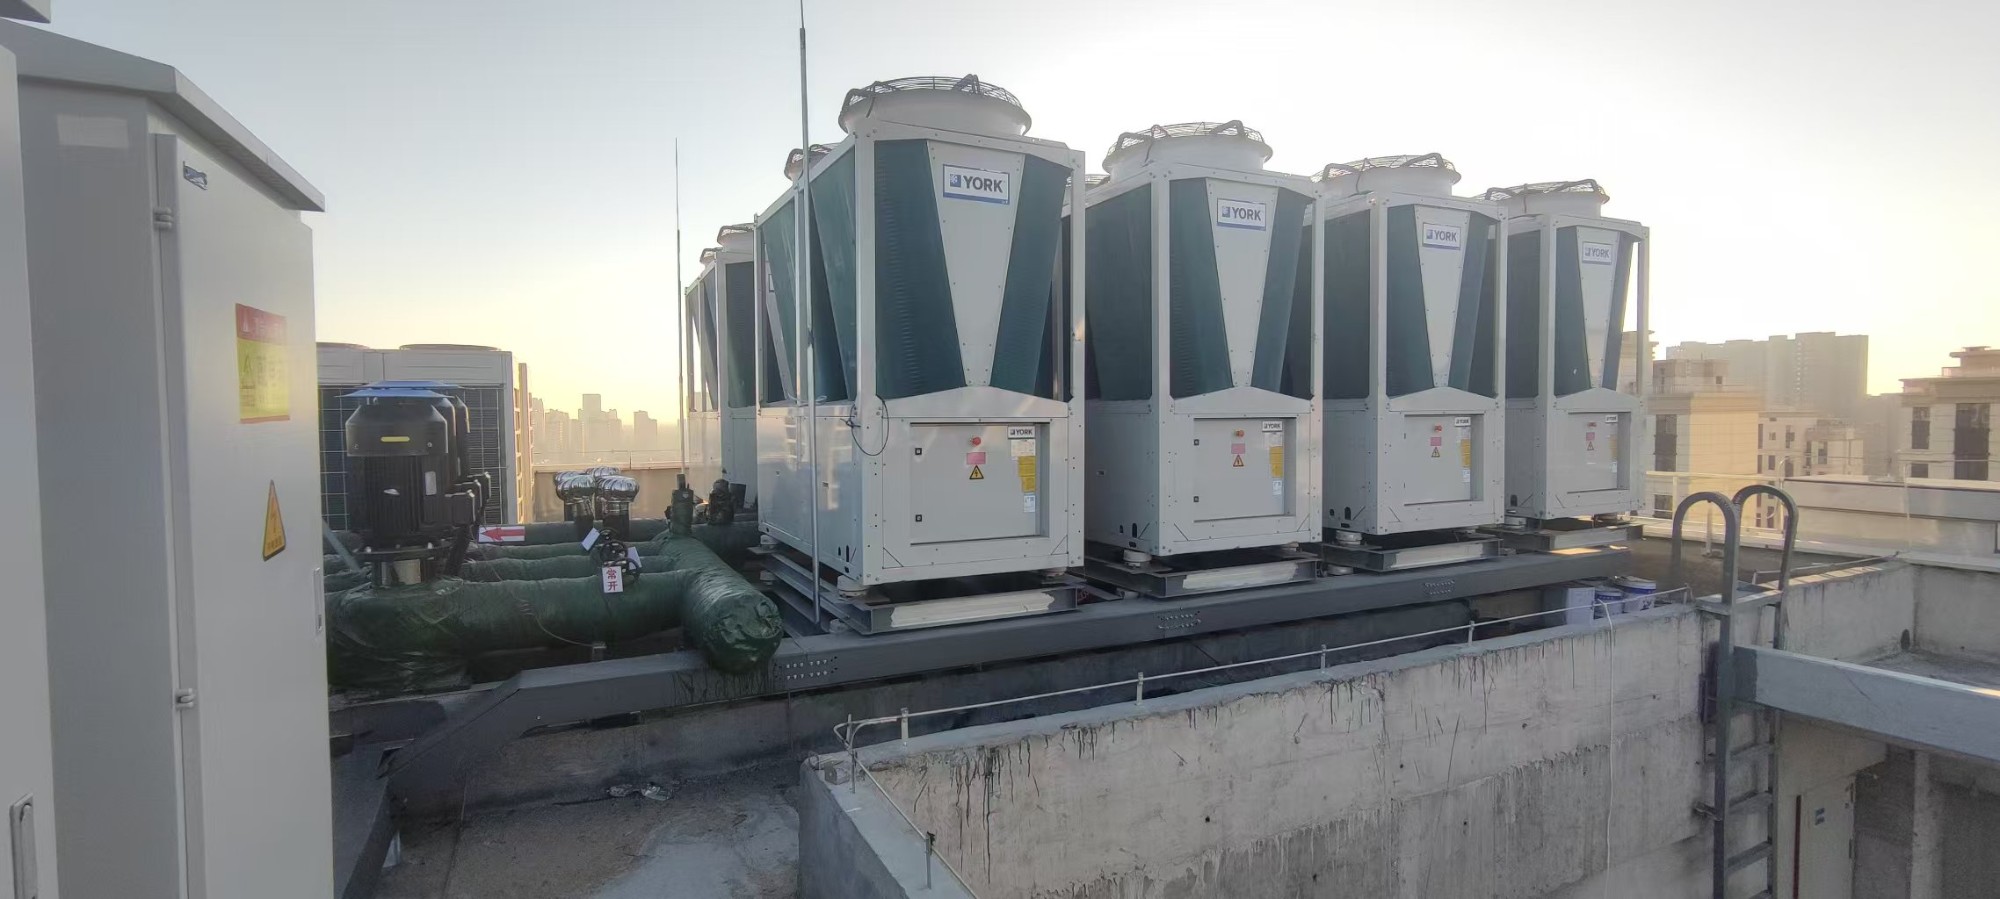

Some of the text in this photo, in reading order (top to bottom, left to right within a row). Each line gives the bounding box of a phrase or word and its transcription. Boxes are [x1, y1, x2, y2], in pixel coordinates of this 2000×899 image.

[963, 175, 1003, 193] YORK
[1231, 206, 1262, 221] YORK
[1434, 230, 1457, 242] YORK
[1591, 247, 1610, 258] YORK
[1015, 428, 1033, 436] YORK
[606, 568, 618, 591] 常开
